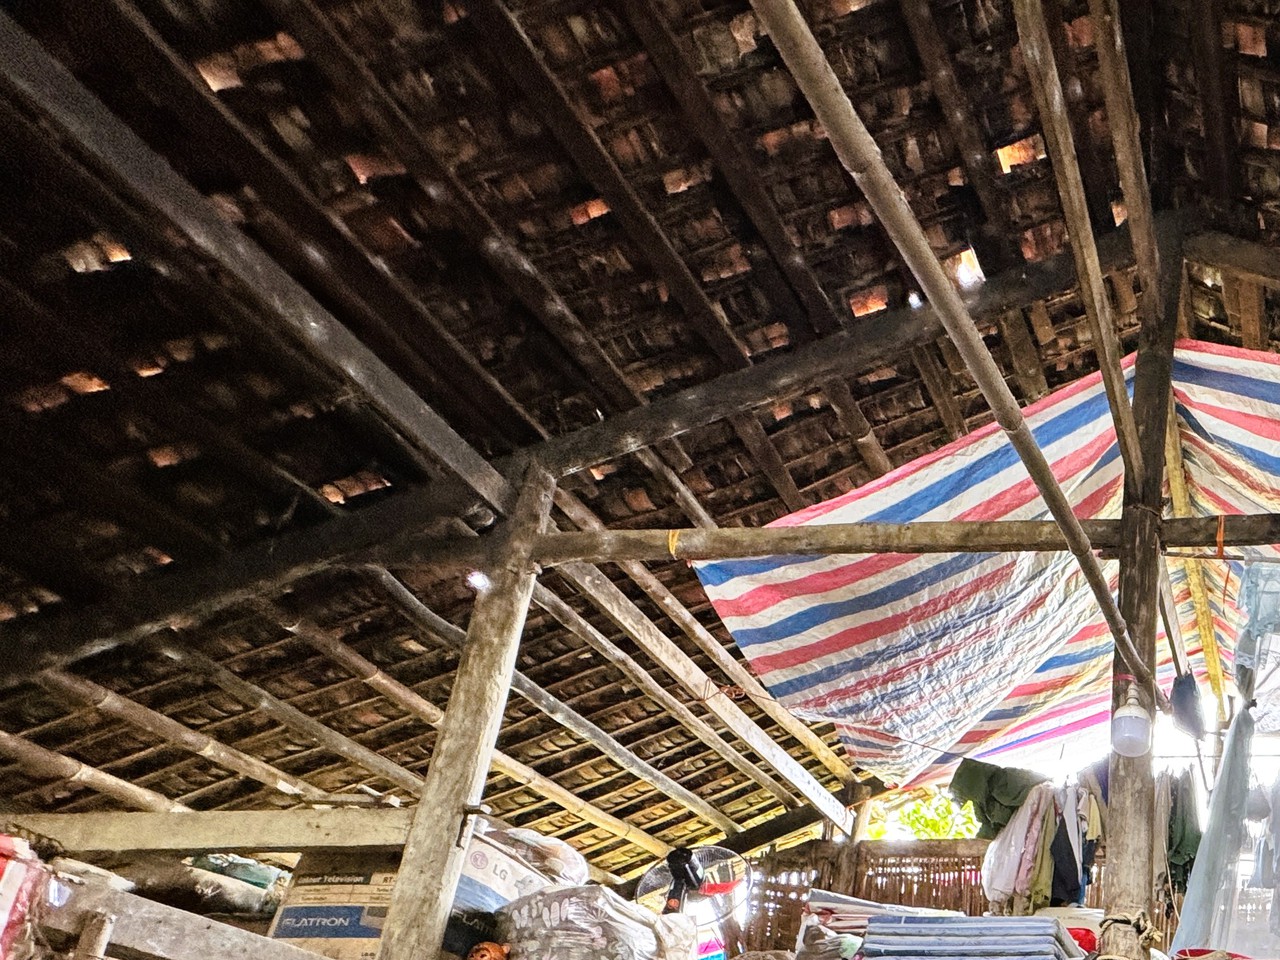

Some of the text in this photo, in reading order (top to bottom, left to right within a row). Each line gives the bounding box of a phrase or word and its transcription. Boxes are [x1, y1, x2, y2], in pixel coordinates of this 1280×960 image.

[492, 864, 508, 881] LG
[323, 875, 365, 884] Television
[281, 916, 350, 927] FLATRON
